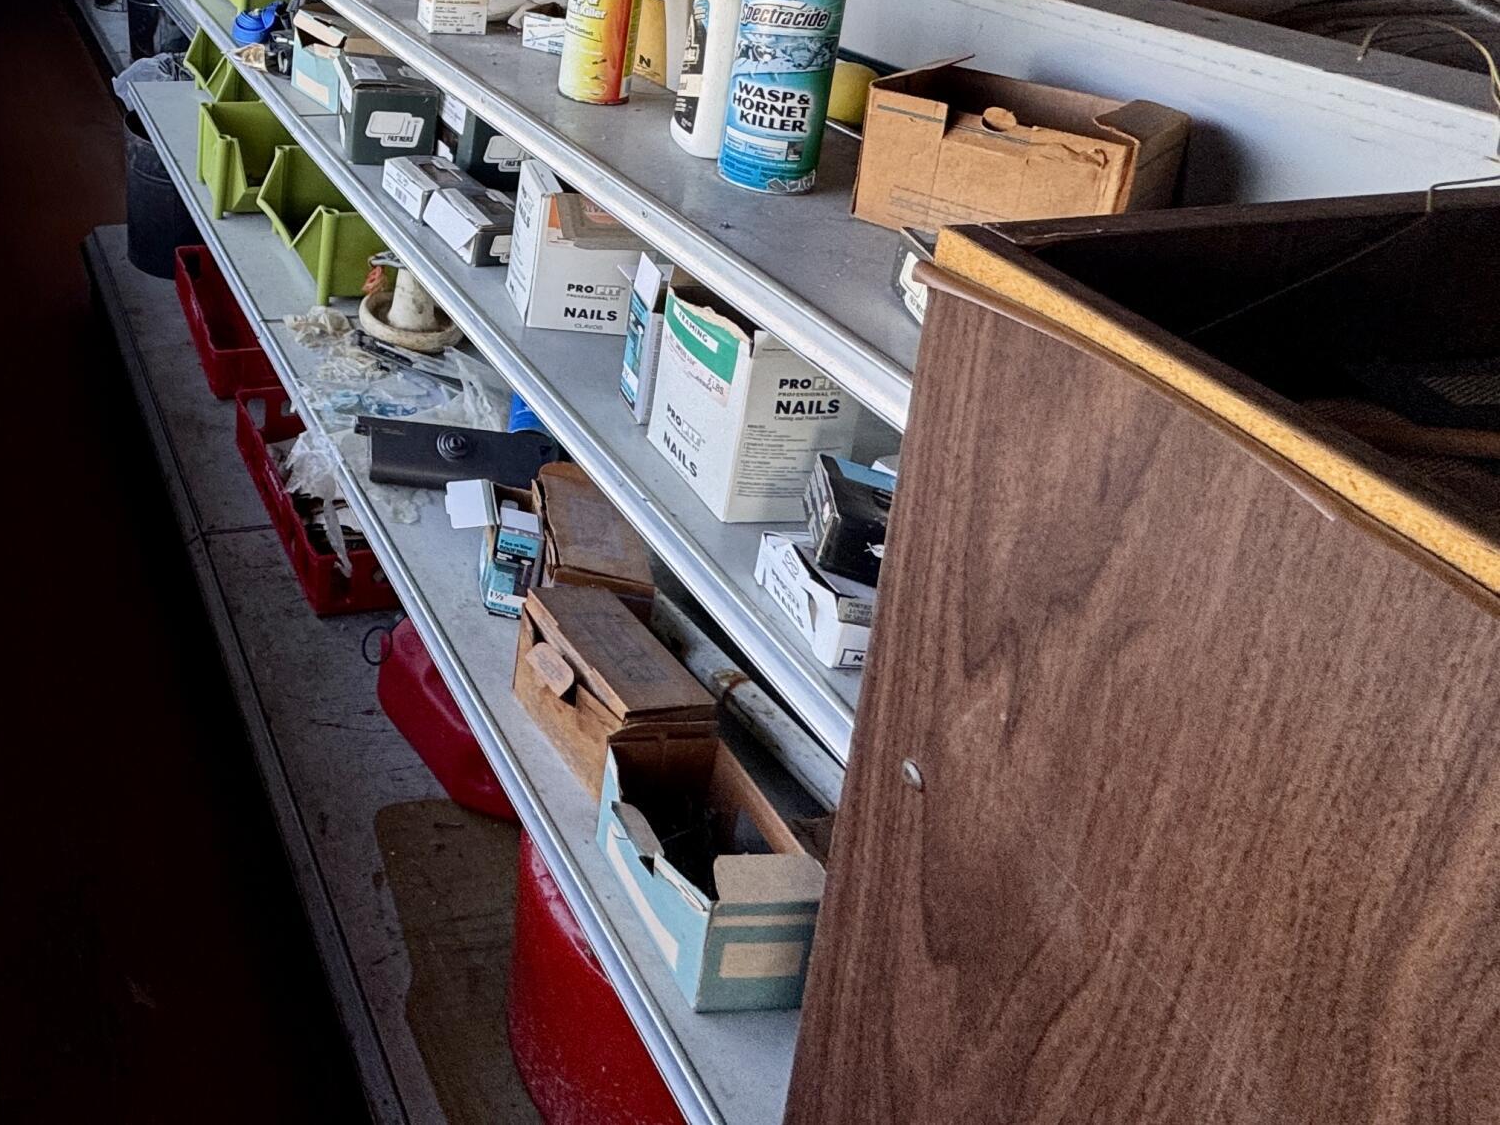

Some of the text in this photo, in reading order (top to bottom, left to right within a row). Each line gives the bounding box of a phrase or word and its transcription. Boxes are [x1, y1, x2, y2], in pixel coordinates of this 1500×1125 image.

[740, 2, 832, 30] Spectracide
[732, 92, 810, 119] HORNET
[738, 80, 811, 105] WASP &
[563, 307, 618, 321] NAILS
[775, 399, 840, 415] NAILS
[663, 431, 698, 478] NAILS
